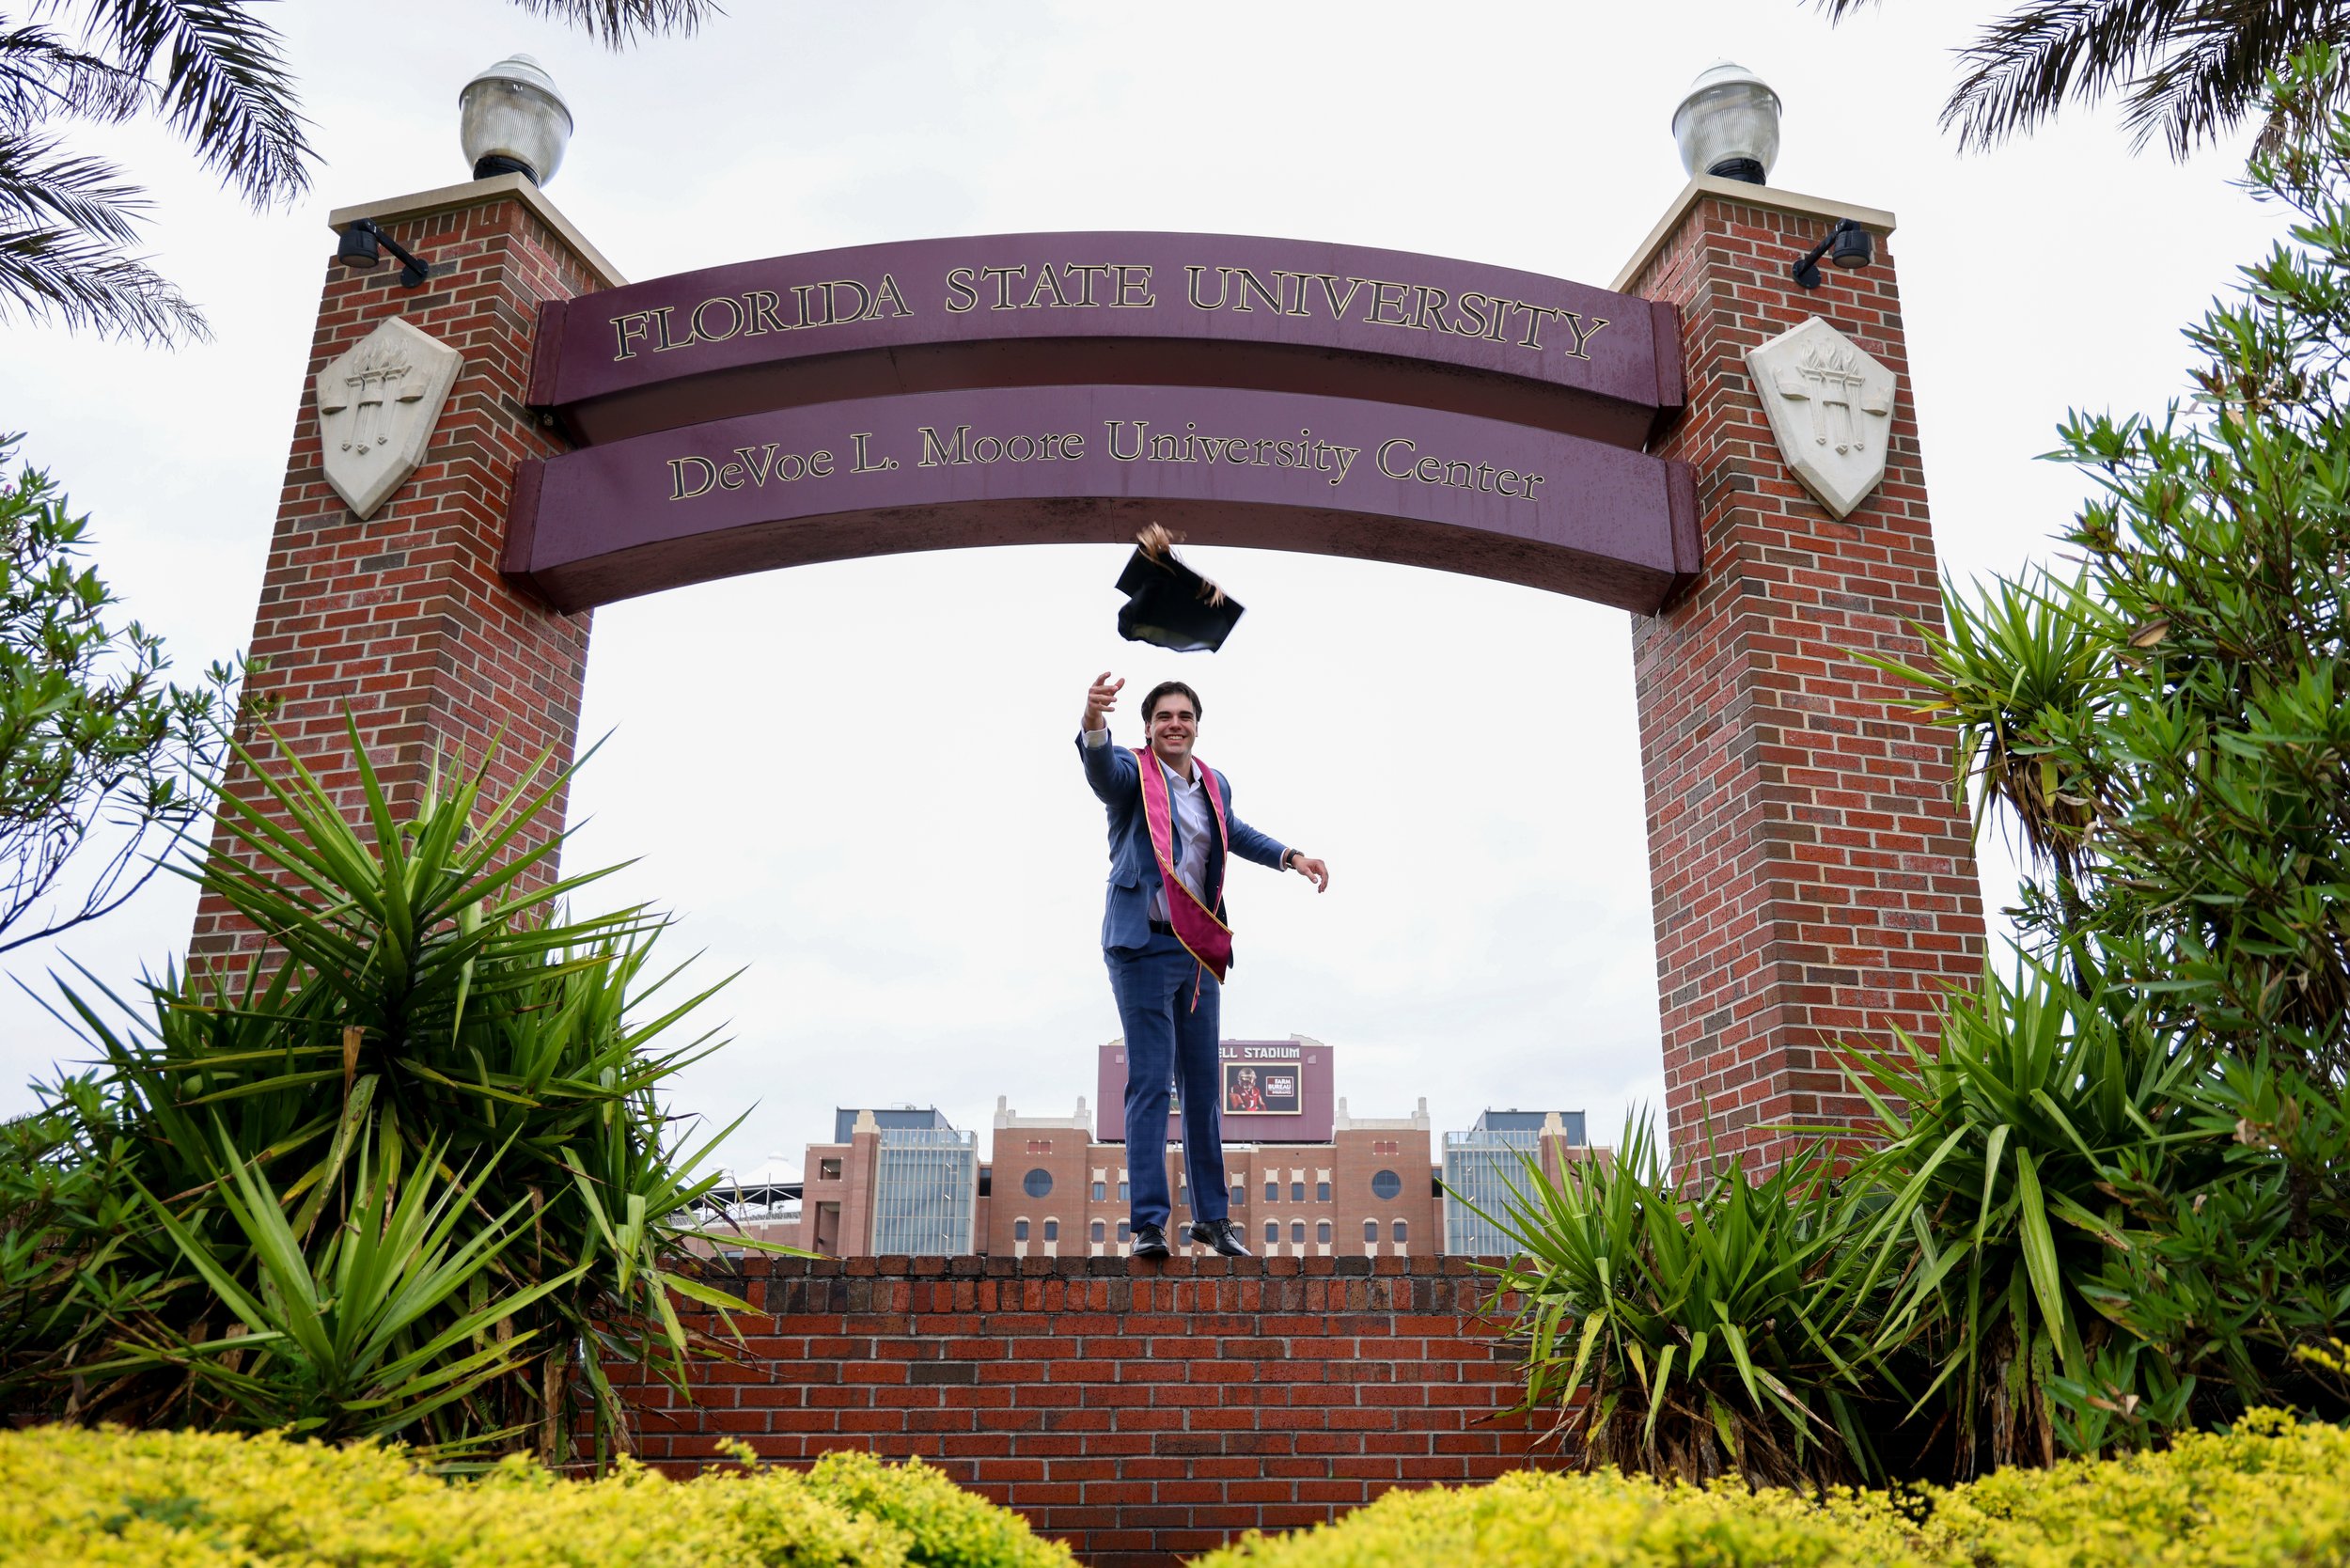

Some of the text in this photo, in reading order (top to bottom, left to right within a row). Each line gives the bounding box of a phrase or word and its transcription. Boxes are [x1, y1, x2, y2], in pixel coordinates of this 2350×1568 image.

[610, 262, 1609, 361] FLORIDA STATE UNIVERSITY
[667, 420, 1544, 501] DeVoe L. Moore University Center
[1244, 1047, 1300, 1058] STADIUM
